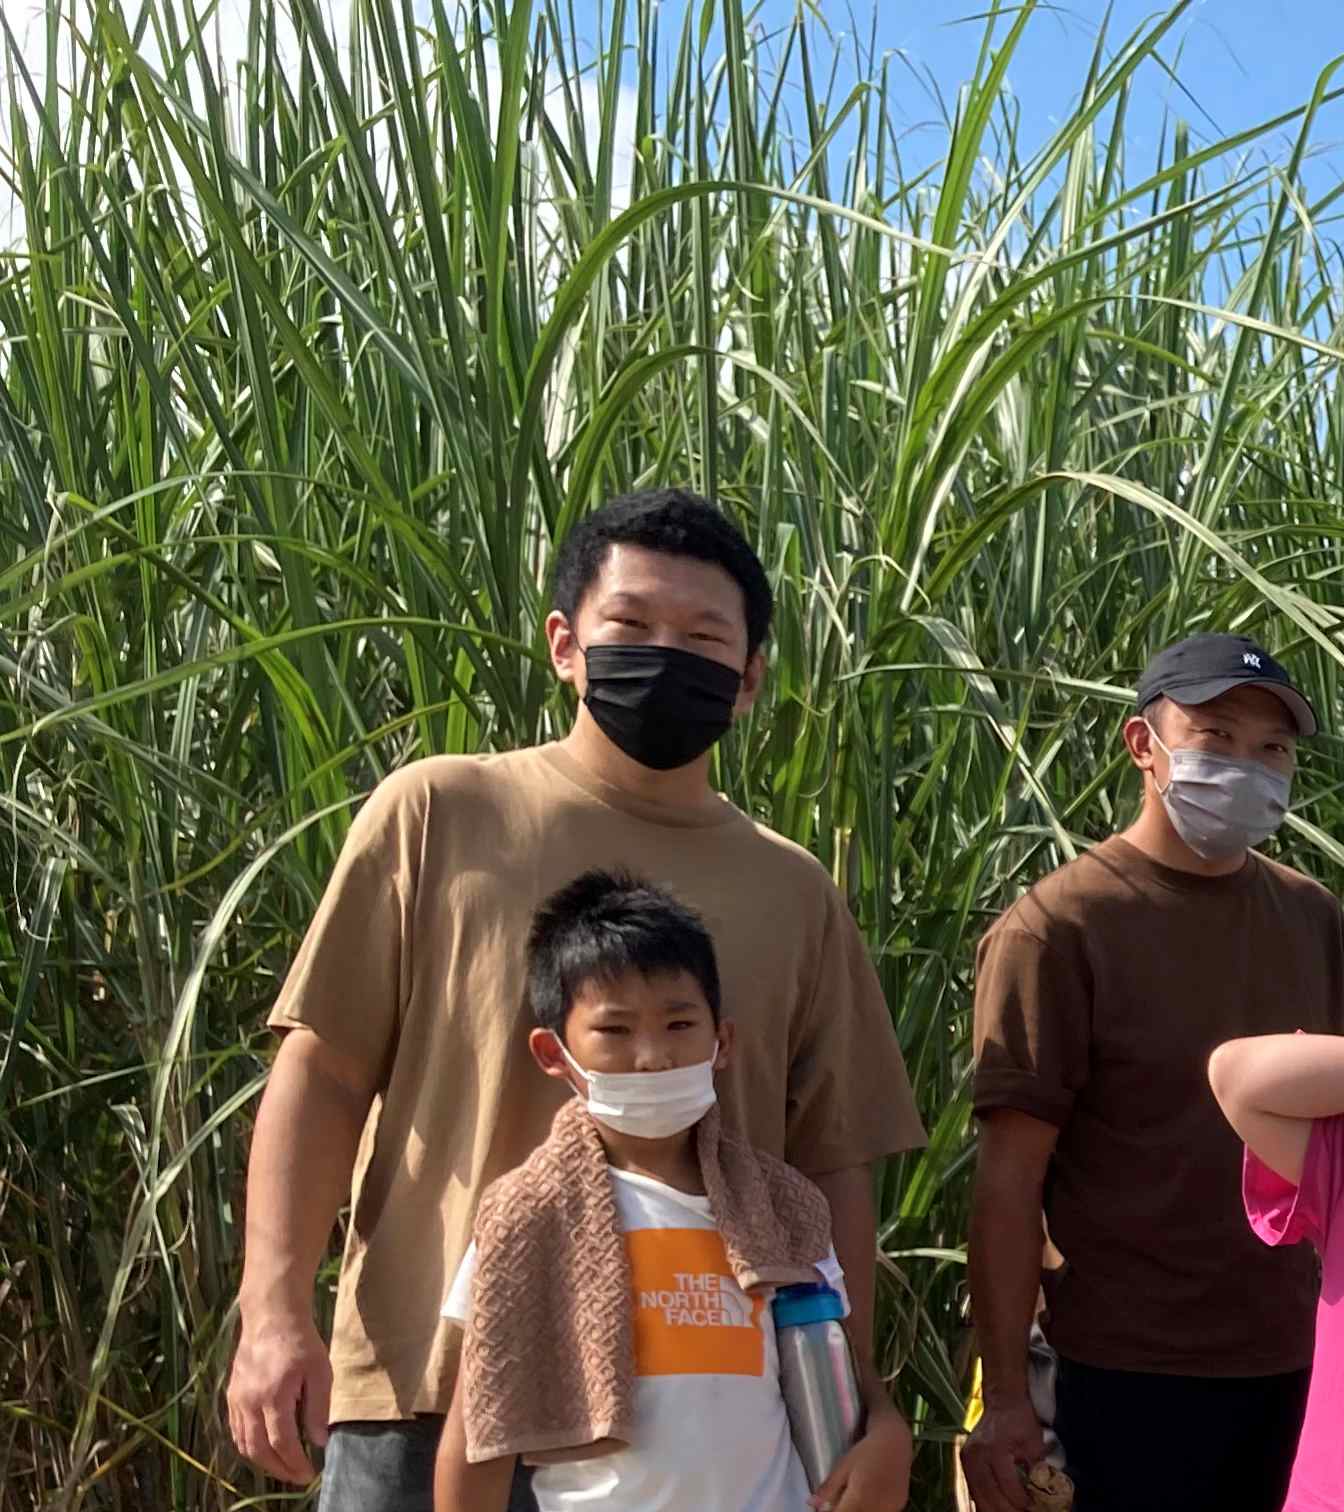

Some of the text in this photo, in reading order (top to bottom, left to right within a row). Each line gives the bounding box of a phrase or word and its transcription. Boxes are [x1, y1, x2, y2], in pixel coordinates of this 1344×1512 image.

[672, 1272, 718, 1292] THE
[640, 1290, 721, 1309] NORTH
[664, 1308, 721, 1328] FACE
